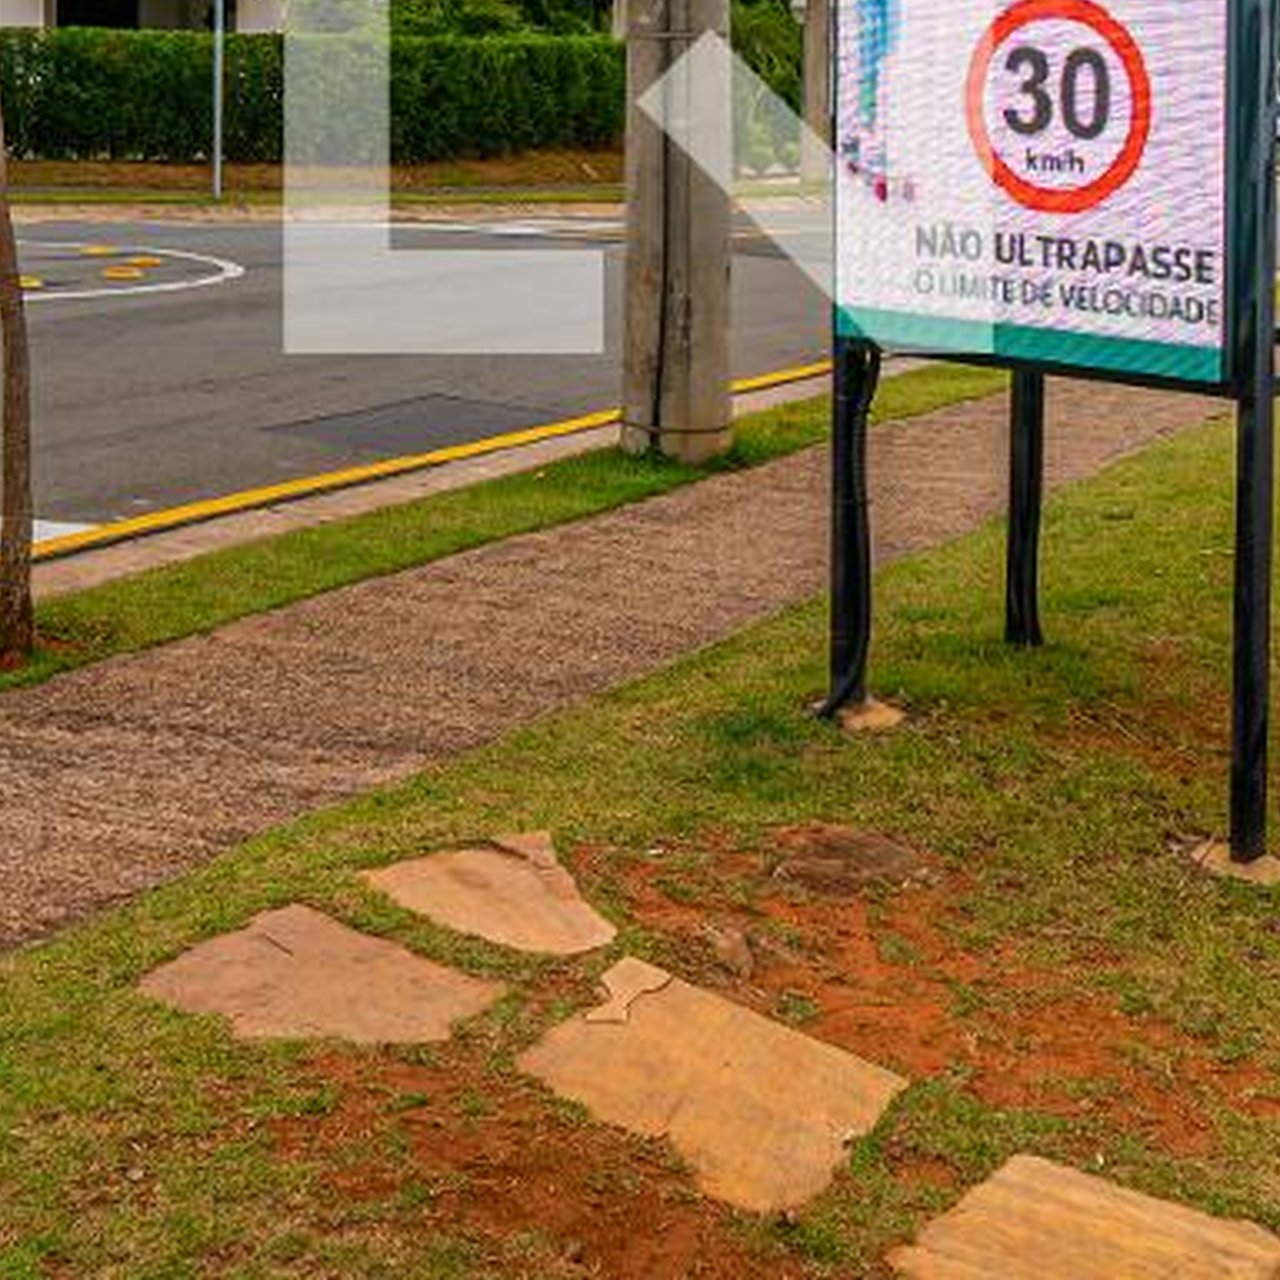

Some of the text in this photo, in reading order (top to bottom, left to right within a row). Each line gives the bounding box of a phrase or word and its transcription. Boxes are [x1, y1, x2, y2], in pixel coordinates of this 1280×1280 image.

[1002, 46, 1110, 140] 30
[915, 222, 1216, 284] NÃO ULTRAPASSE
[914, 270, 933, 294] O
[1022, 278, 1054, 307] DE
[1058, 283, 1219, 324] VELOCIDADE
